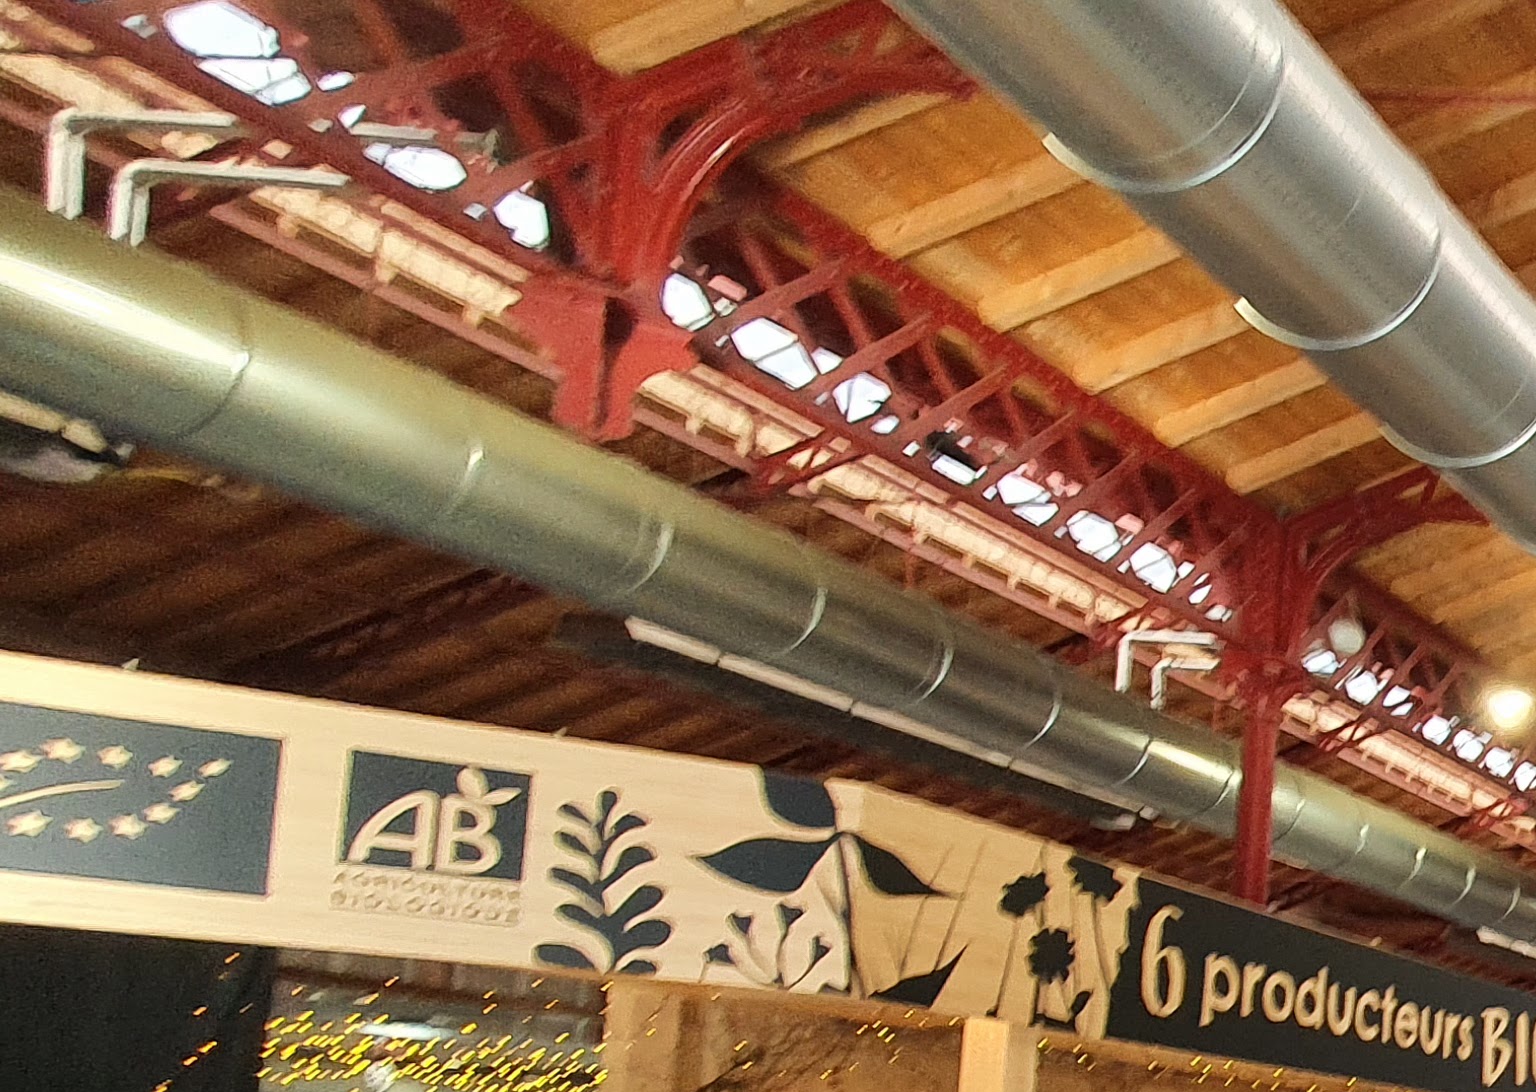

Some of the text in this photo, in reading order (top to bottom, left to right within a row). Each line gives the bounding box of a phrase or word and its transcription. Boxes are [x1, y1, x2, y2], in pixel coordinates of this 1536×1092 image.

[346, 788, 502, 875] AB
[1140, 904, 1188, 1018] 6
[1200, 950, 1475, 1063] producteurs
